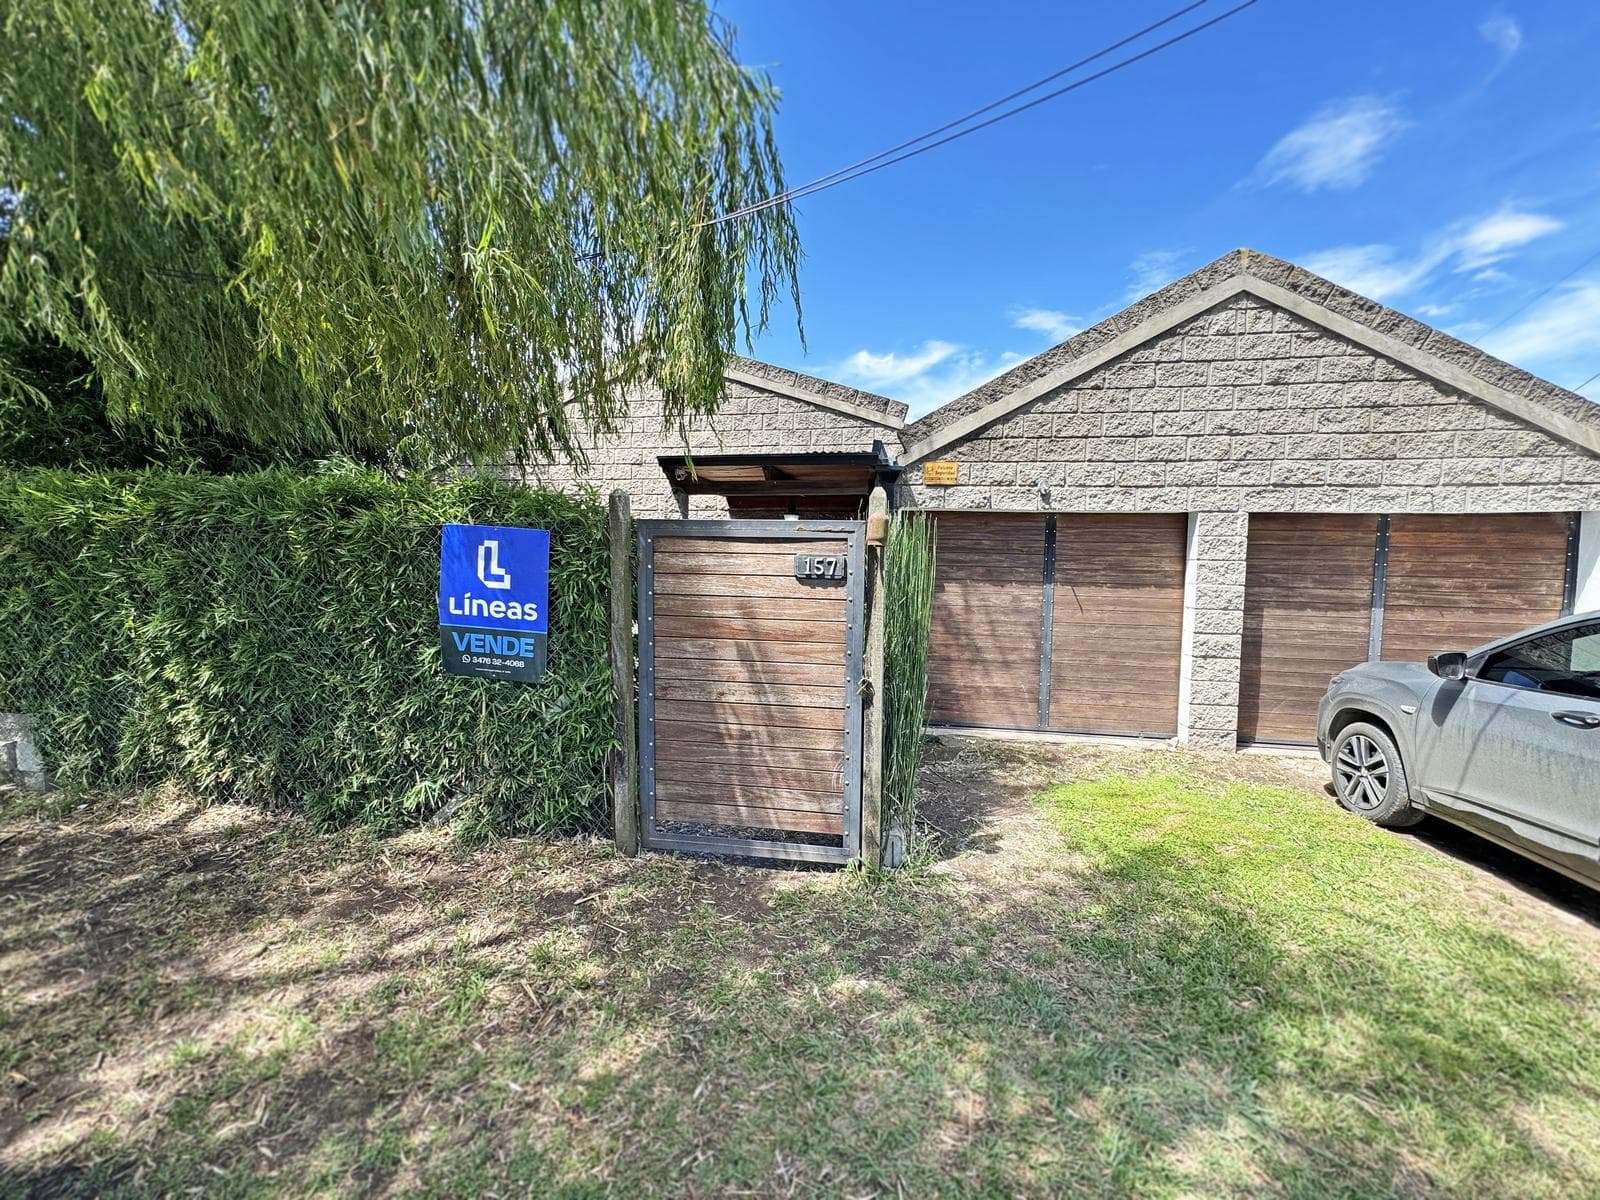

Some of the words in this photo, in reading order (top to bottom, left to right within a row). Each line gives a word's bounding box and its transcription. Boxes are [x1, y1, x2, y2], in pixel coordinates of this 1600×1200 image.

[804, 557, 837, 575] 157
[449, 592, 538, 621] Líneas
[452, 631, 535, 658] VENDE
